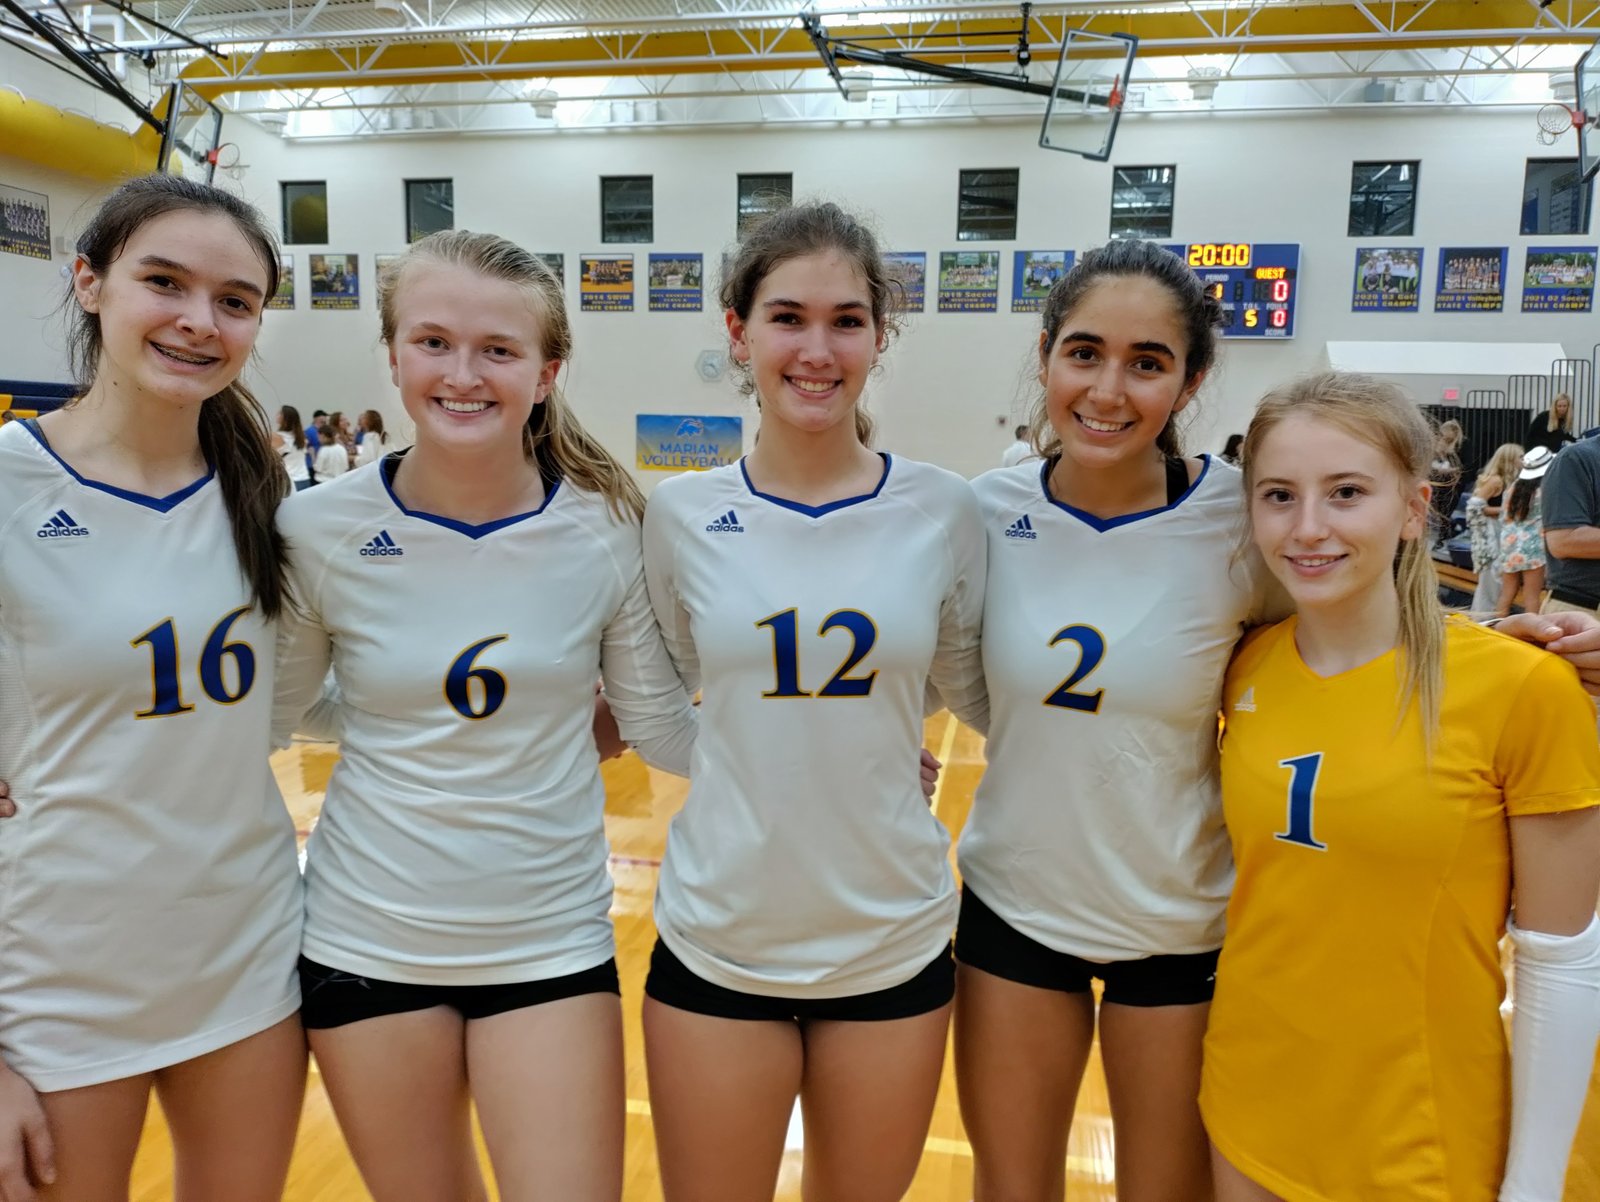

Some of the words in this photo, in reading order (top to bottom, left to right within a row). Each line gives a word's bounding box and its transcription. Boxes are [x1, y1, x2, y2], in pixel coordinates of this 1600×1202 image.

[1189, 244, 1249, 266] 20:00
[1205, 274, 1229, 282] PERIOD
[1255, 267, 1286, 279] GUEST
[1273, 281, 1289, 302] 0
[1272, 310, 1287, 327] 0
[1265, 328, 1287, 337] SCORE
[659, 443, 719, 455] MARIAN
[36, 526, 90, 538] adidas
[705, 522, 745, 533] adidas
[1004, 528, 1037, 540] adidas
[359, 545, 404, 556] adidas
[753, 606, 880, 699] 12
[129, 604, 256, 720] 16
[1041, 623, 1108, 715] 2
[442, 633, 509, 721] 6
[1273, 751, 1329, 851] 1
